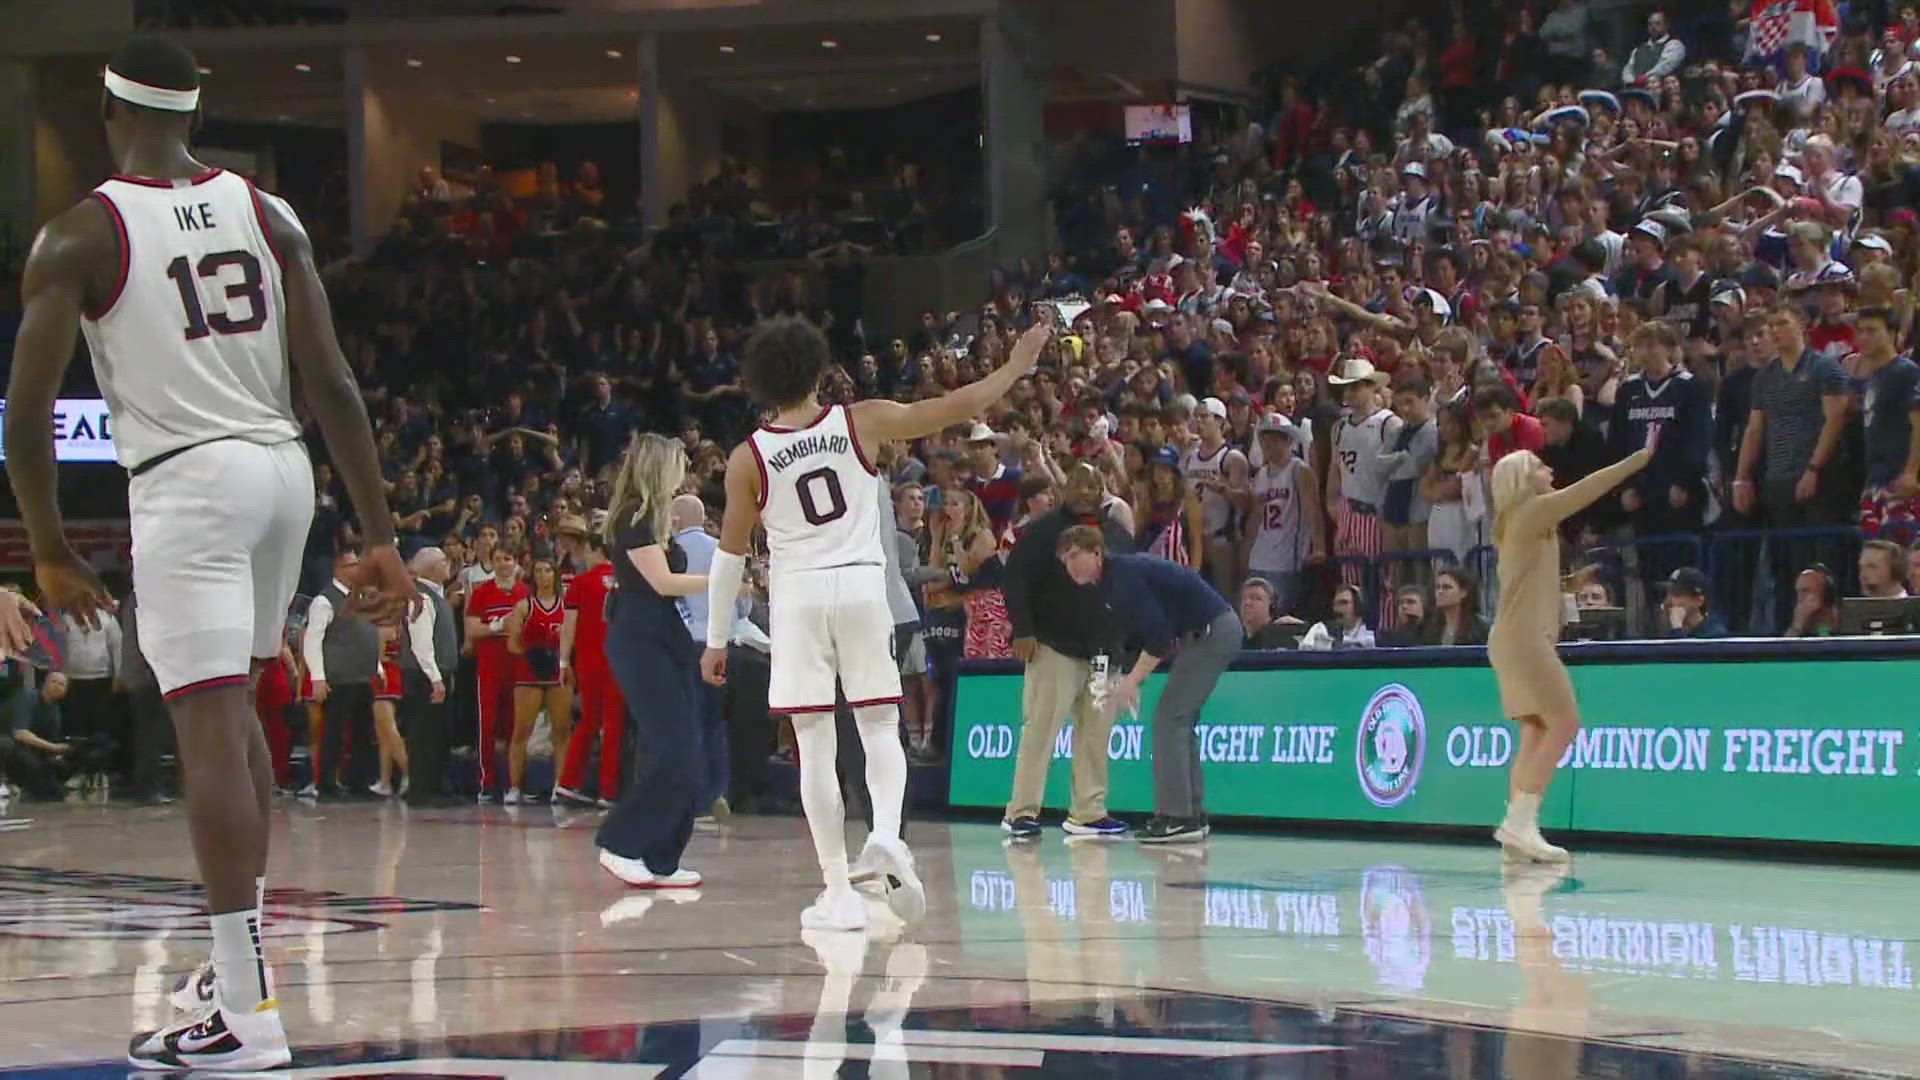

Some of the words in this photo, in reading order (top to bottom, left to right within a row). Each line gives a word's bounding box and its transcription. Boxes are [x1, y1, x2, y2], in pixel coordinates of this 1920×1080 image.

[173, 202, 216, 231] IKE
[167, 249, 268, 341] 13
[768, 434, 849, 473] NEMBHARD
[795, 466, 848, 526] 0
[967, 723, 1014, 759] OLD
[1271, 724, 1339, 764] LINE
[1446, 725, 1512, 767] OLD
[1723, 727, 1904, 777] FREIGHT
